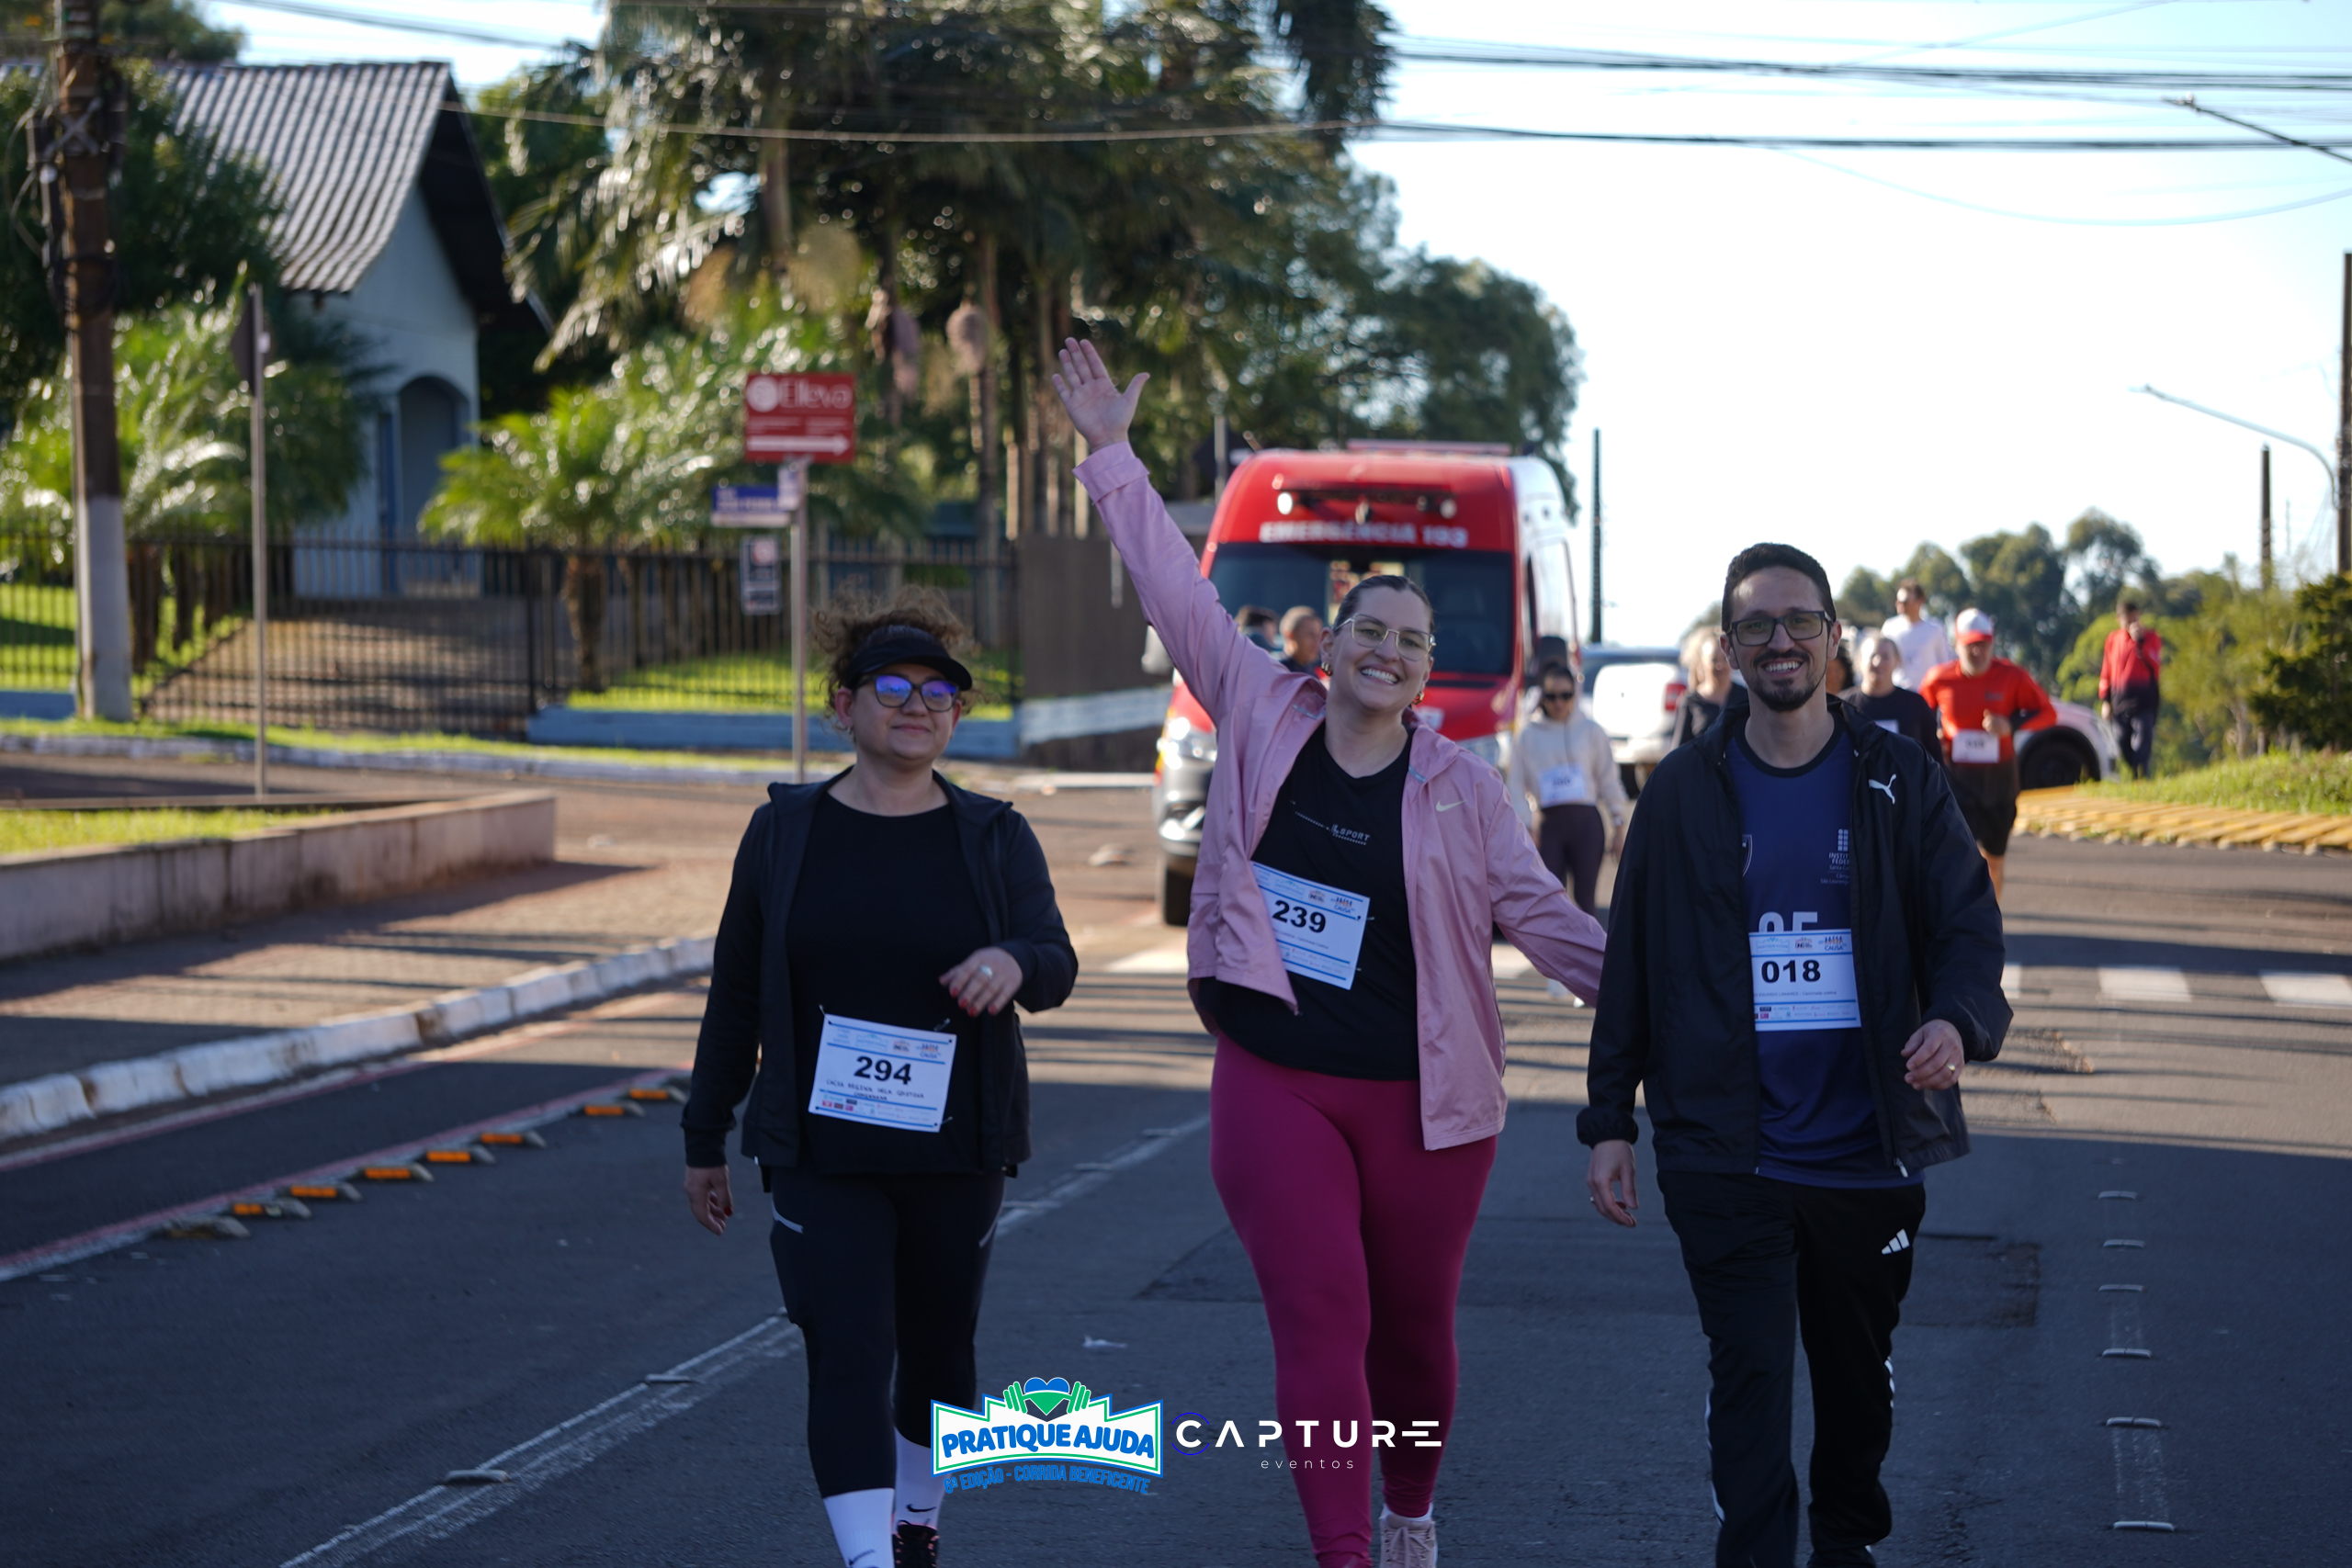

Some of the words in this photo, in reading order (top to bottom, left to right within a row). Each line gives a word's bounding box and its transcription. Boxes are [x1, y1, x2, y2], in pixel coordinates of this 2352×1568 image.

[1422, 525, 1468, 548] 193
[1272, 900, 1327, 933] 239
[1761, 960, 1821, 983] 018
[854, 1056, 911, 1085] 294
